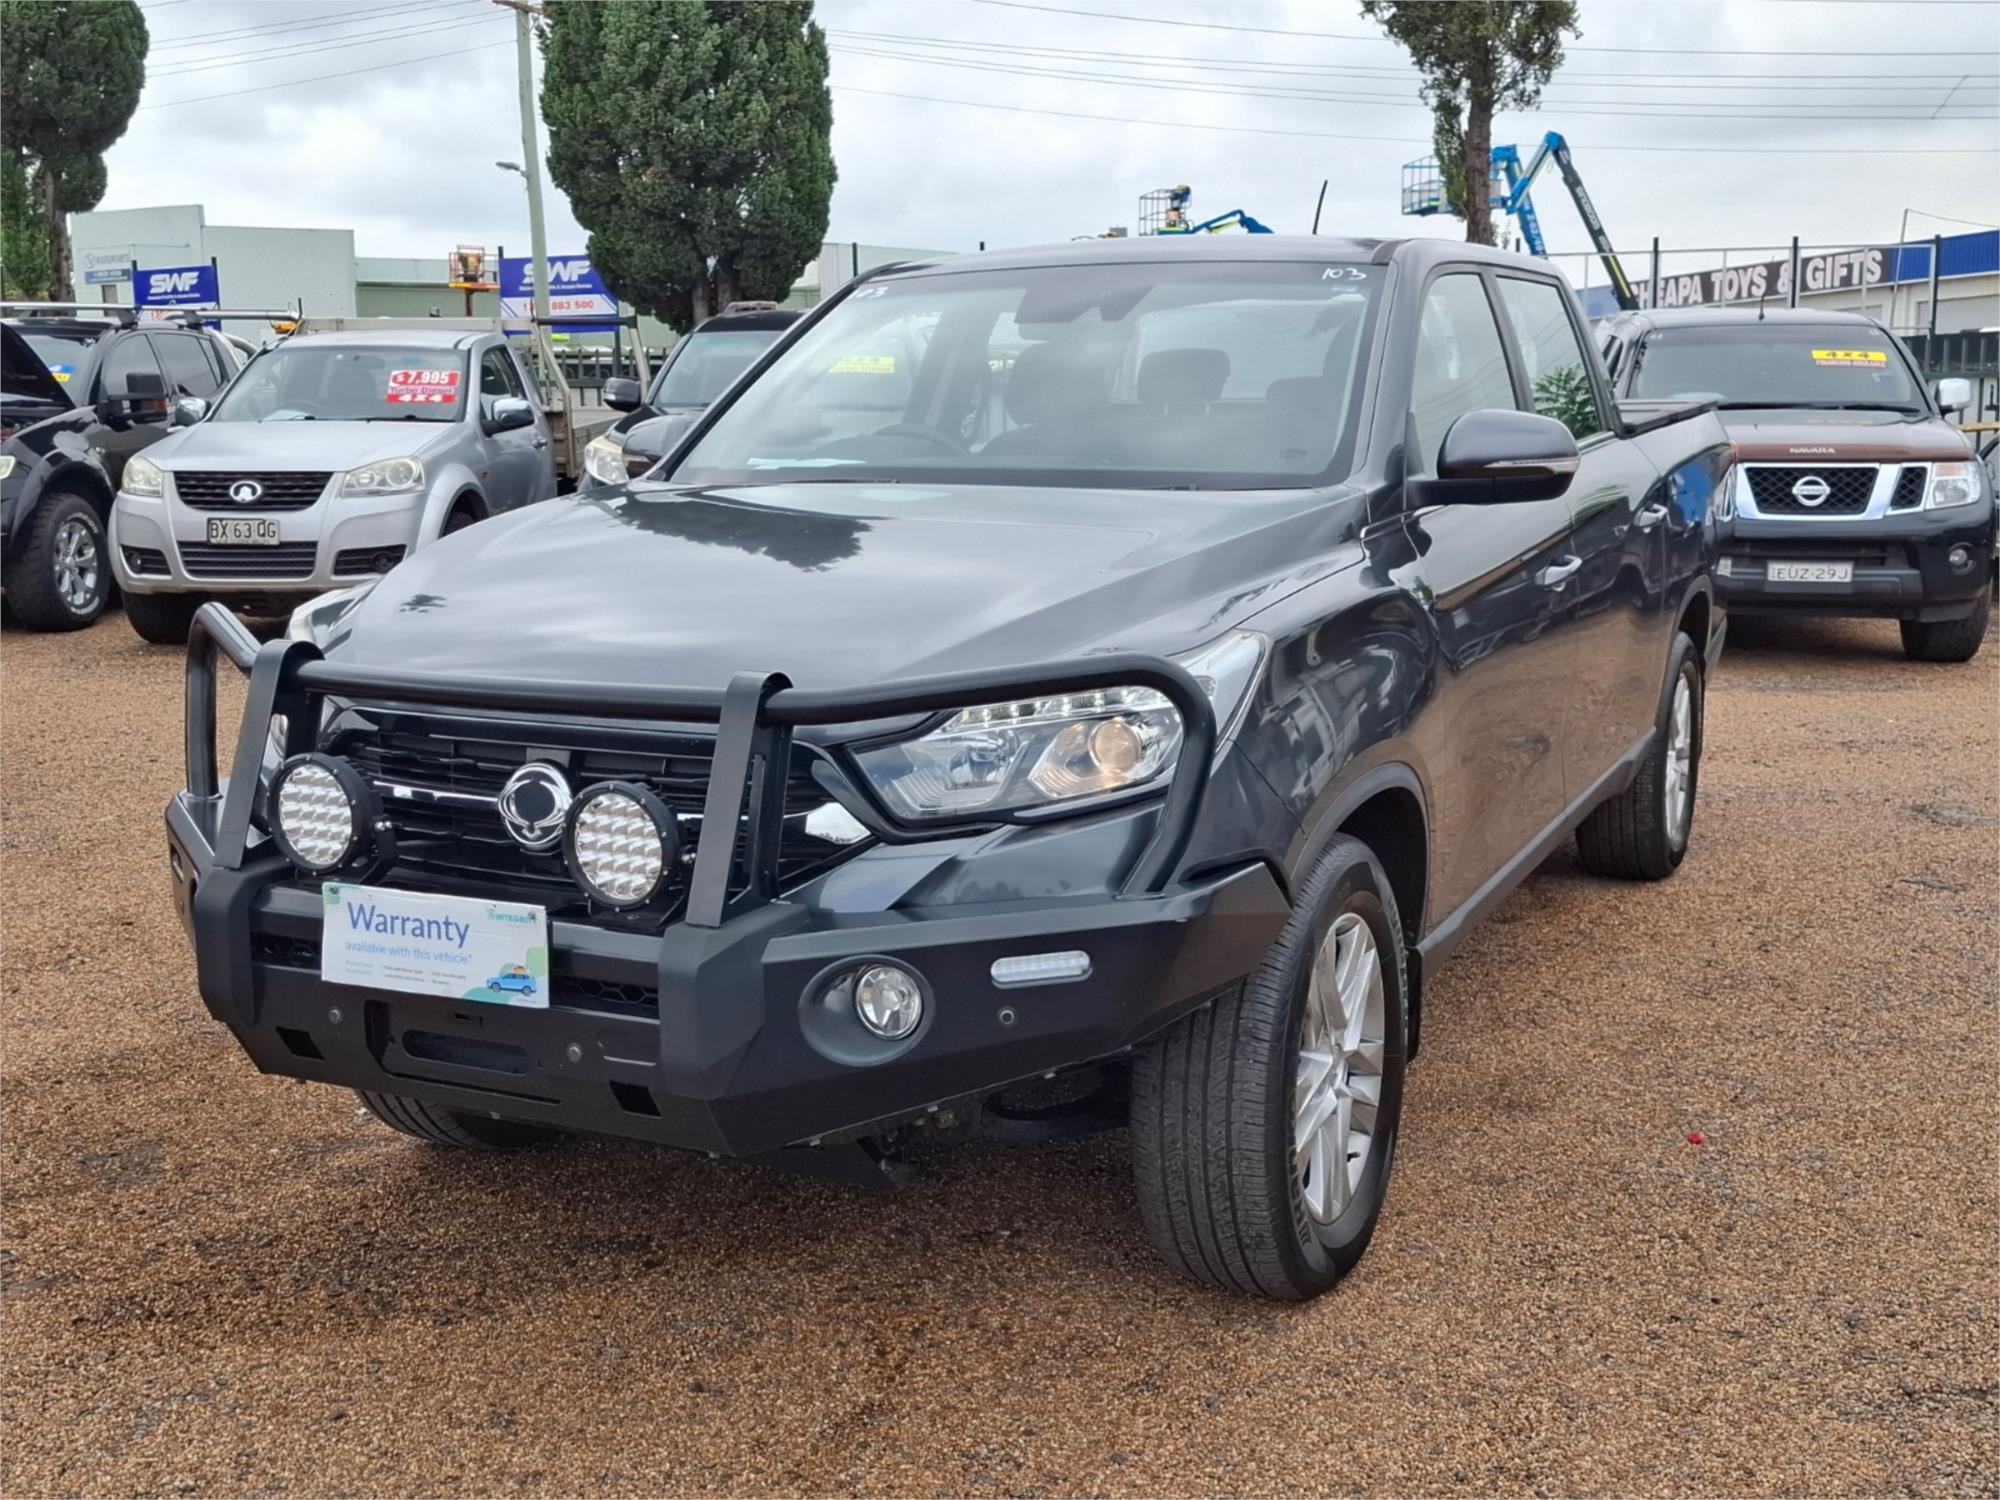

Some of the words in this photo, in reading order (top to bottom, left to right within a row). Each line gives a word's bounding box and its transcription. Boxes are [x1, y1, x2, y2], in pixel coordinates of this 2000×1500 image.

[150, 271, 199, 294] SWF
[1322, 267, 1367, 280] 103
[1711, 266, 1767, 300] TOYS
[1806, 250, 1882, 290] GIFTS
[575, 300, 593, 310] 500
[1789, 447, 1836, 455] NAVARA
[347, 901, 470, 949] Warranty
[345, 941, 386, 955] available
[388, 945, 411, 958] with
[413, 948, 431, 960] this
